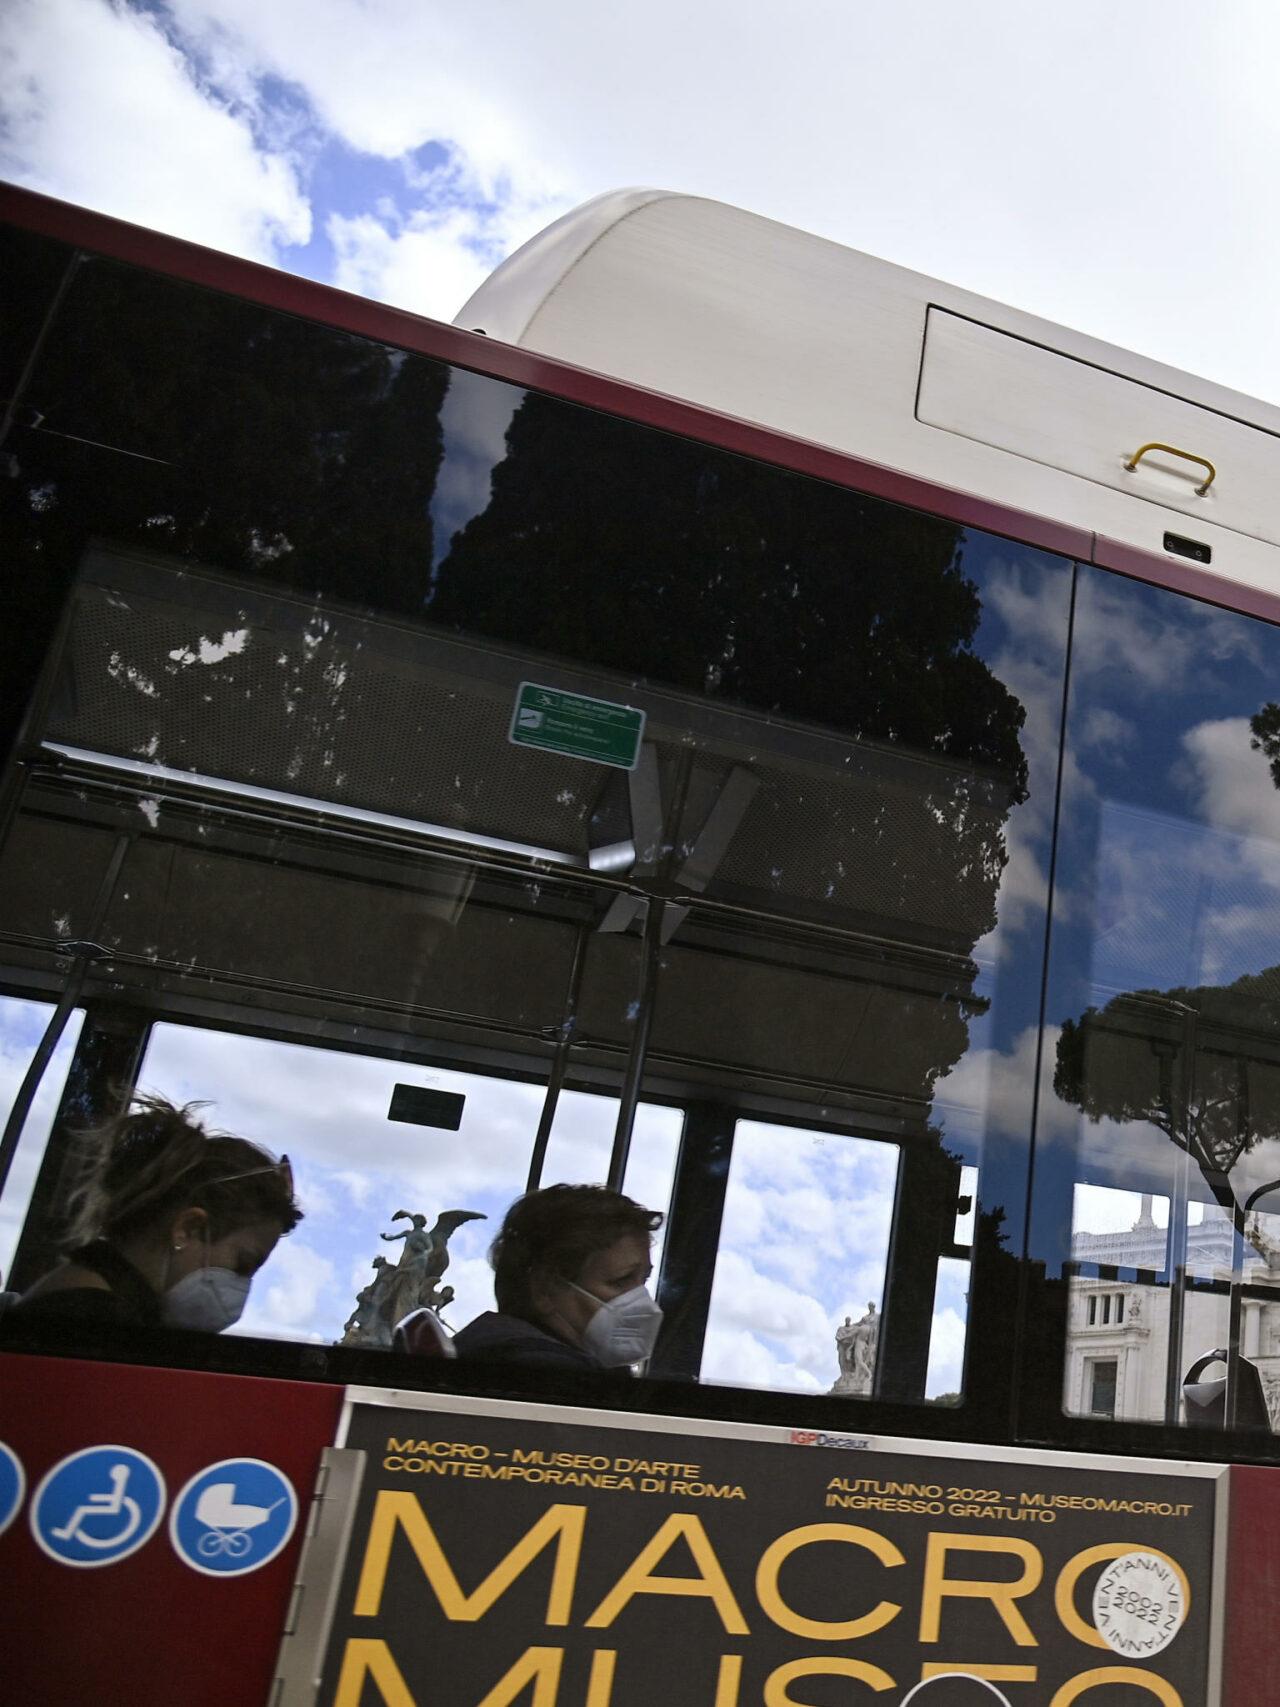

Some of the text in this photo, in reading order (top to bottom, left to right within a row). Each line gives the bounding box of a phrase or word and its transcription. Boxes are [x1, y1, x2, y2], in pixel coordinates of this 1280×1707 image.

[386, 1437, 489, 1460] MACRO
[511, 1449, 610, 1470] MUSEO
[614, 1458, 701, 1479] D'ARTE
[790, 1431, 870, 1450] IGPDecaux
[382, 1456, 747, 1500] CONTEMPORANEA DI ROMA
[825, 1493, 1057, 1523] INGRESSO GRATUITO
[826, 1476, 943, 1499] AUTUNNO
[946, 1486, 1001, 1502] 2022
[1019, 1492, 1193, 1518] MUSEOMACRO.IT
[353, 1489, 1191, 1650] MACRO
[1113, 1596, 1161, 1626] 2022
[1116, 1585, 1163, 1615] 2002
